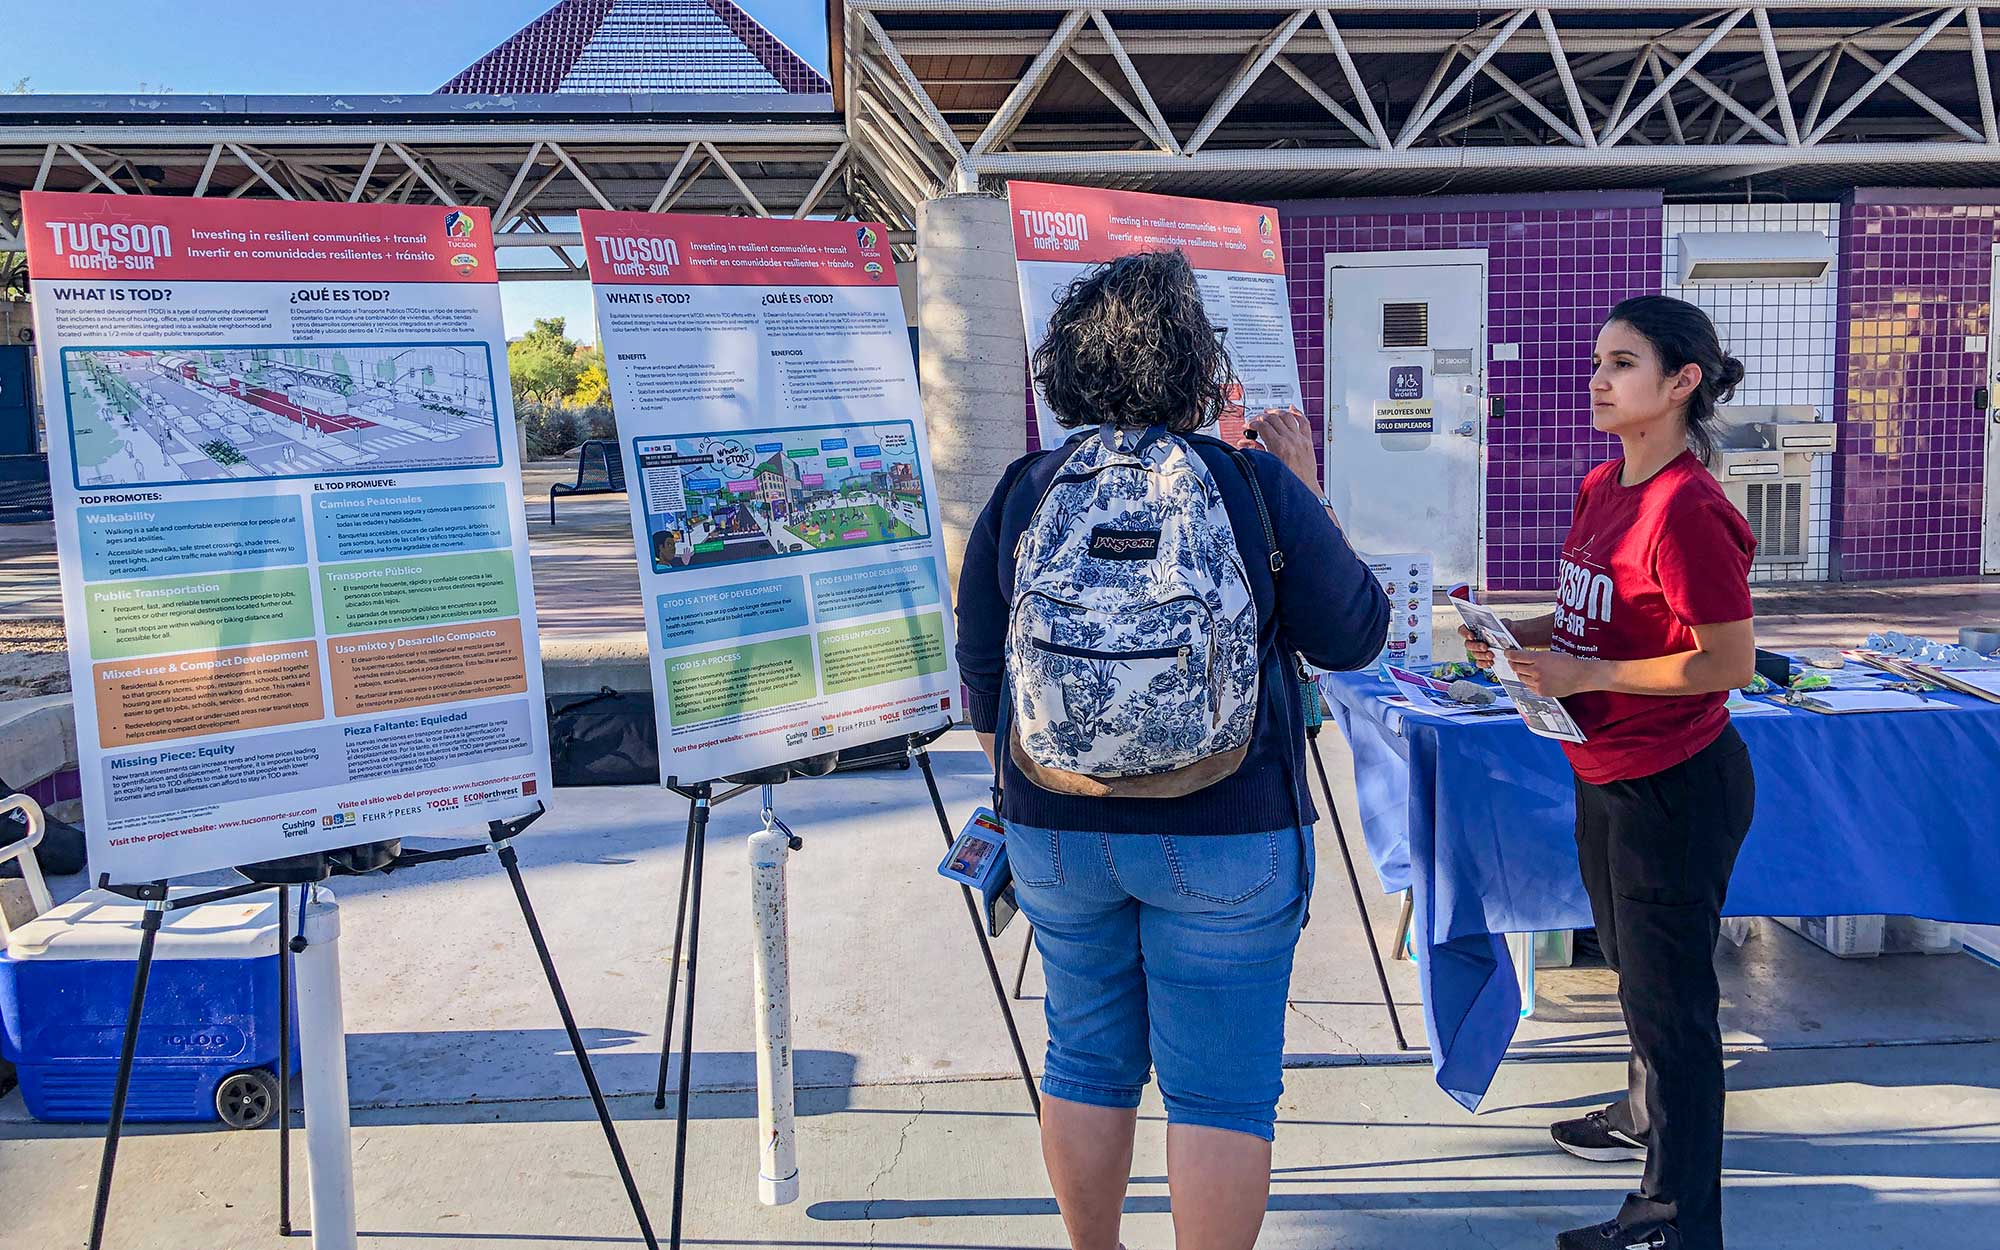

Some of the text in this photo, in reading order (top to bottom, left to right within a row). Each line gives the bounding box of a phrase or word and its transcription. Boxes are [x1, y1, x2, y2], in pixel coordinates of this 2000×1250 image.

[1020, 209, 1088, 240] TUCSON
[1108, 213, 1142, 228] Investing
[1140, 215, 1149, 229] in
[1148, 216, 1178, 231] resilient
[1176, 218, 1216, 232] communities
[1222, 224, 1241, 233] transit
[46, 222, 172, 257] TUCSON
[191, 228, 246, 242] Investing
[249, 229, 260, 240] in
[264, 229, 309, 240] resilient
[312, 232, 380, 242] communities
[393, 233, 426, 243] transit
[1107, 229, 1133, 243] Invertir
[1133, 235, 1143, 245] en
[1143, 233, 1187, 249] comunidades
[1186, 236, 1219, 249] resilientes
[1224, 239, 1246, 249] tránsito
[187, 246, 230, 257] Invertir
[251, 247, 326, 258] comunidades
[328, 248, 382, 259] resilientes
[395, 248, 434, 260] tránsito
[595, 236, 680, 266] TUCSON
[690, 241, 727, 254] Investing
[727, 242, 736, 252] in
[737, 242, 768, 251] resilient
[770, 244, 816, 253] communities
[823, 245, 847, 255] transit
[689, 255, 718, 269] Invertir
[730, 256, 782, 270] comunidades
[782, 257, 819, 269] resilientes
[826, 258, 853, 270] tránsito
[52, 288, 172, 300] WHAT IS TOD?
[289, 286, 389, 303] ¿QUÉ ES TOD?
[605, 292, 690, 303] WHAT IS eTOD?
[761, 291, 833, 305] ¿QUÉ ES eTOD?
[324, 482, 344, 490] TOD
[345, 478, 396, 488] PROMUEVE:
[78, 492, 161, 504] TOD PROMOTES:
[319, 494, 422, 510] Caminos Peatonales
[86, 511, 156, 523] Walkability
[104, 526, 133, 535] Walking
[173, 520, 212, 530] comfortable
[248, 519, 257, 528] for
[258, 517, 280, 525] people
[326, 565, 422, 581] Transporte Público
[94, 583, 219, 601] Public Transportation
[663, 584, 782, 609] eTOD IS A TYPE OF DEVELOPMENT
[1558, 559, 1613, 622] UCSON
[335, 629, 496, 653] Uso mixto y Desarollo Compacto
[822, 636, 841, 645] eTOD
[849, 631, 860, 639] UN
[861, 626, 890, 636] PROCESO
[102, 647, 308, 679] Mixed-use & Compact Development
[671, 652, 743, 672] eTOD IS A PROCESS
[343, 711, 467, 736] Pieza Faltante: Equiedad
[111, 744, 234, 769] Missing Piece: Equity
[336, 800, 359, 809] Visite
[368, 796, 384, 804] sitio
[385, 793, 402, 801] web
[402, 790, 415, 798] del
[416, 786, 451, 797] proyecto:
[452, 772, 536, 790] www.tucsonnorte-sur.com
[394, 805, 421, 816] PEERS
[426, 797, 458, 809] TOOLE
[362, 812, 388, 822] FEHR
[108, 837, 129, 846] Visit
[147, 829, 178, 842] project
[179, 824, 216, 834] website:
[218, 808, 317, 828] www.tucsonnorte-sur.com
[281, 819, 315, 833] Cushing
